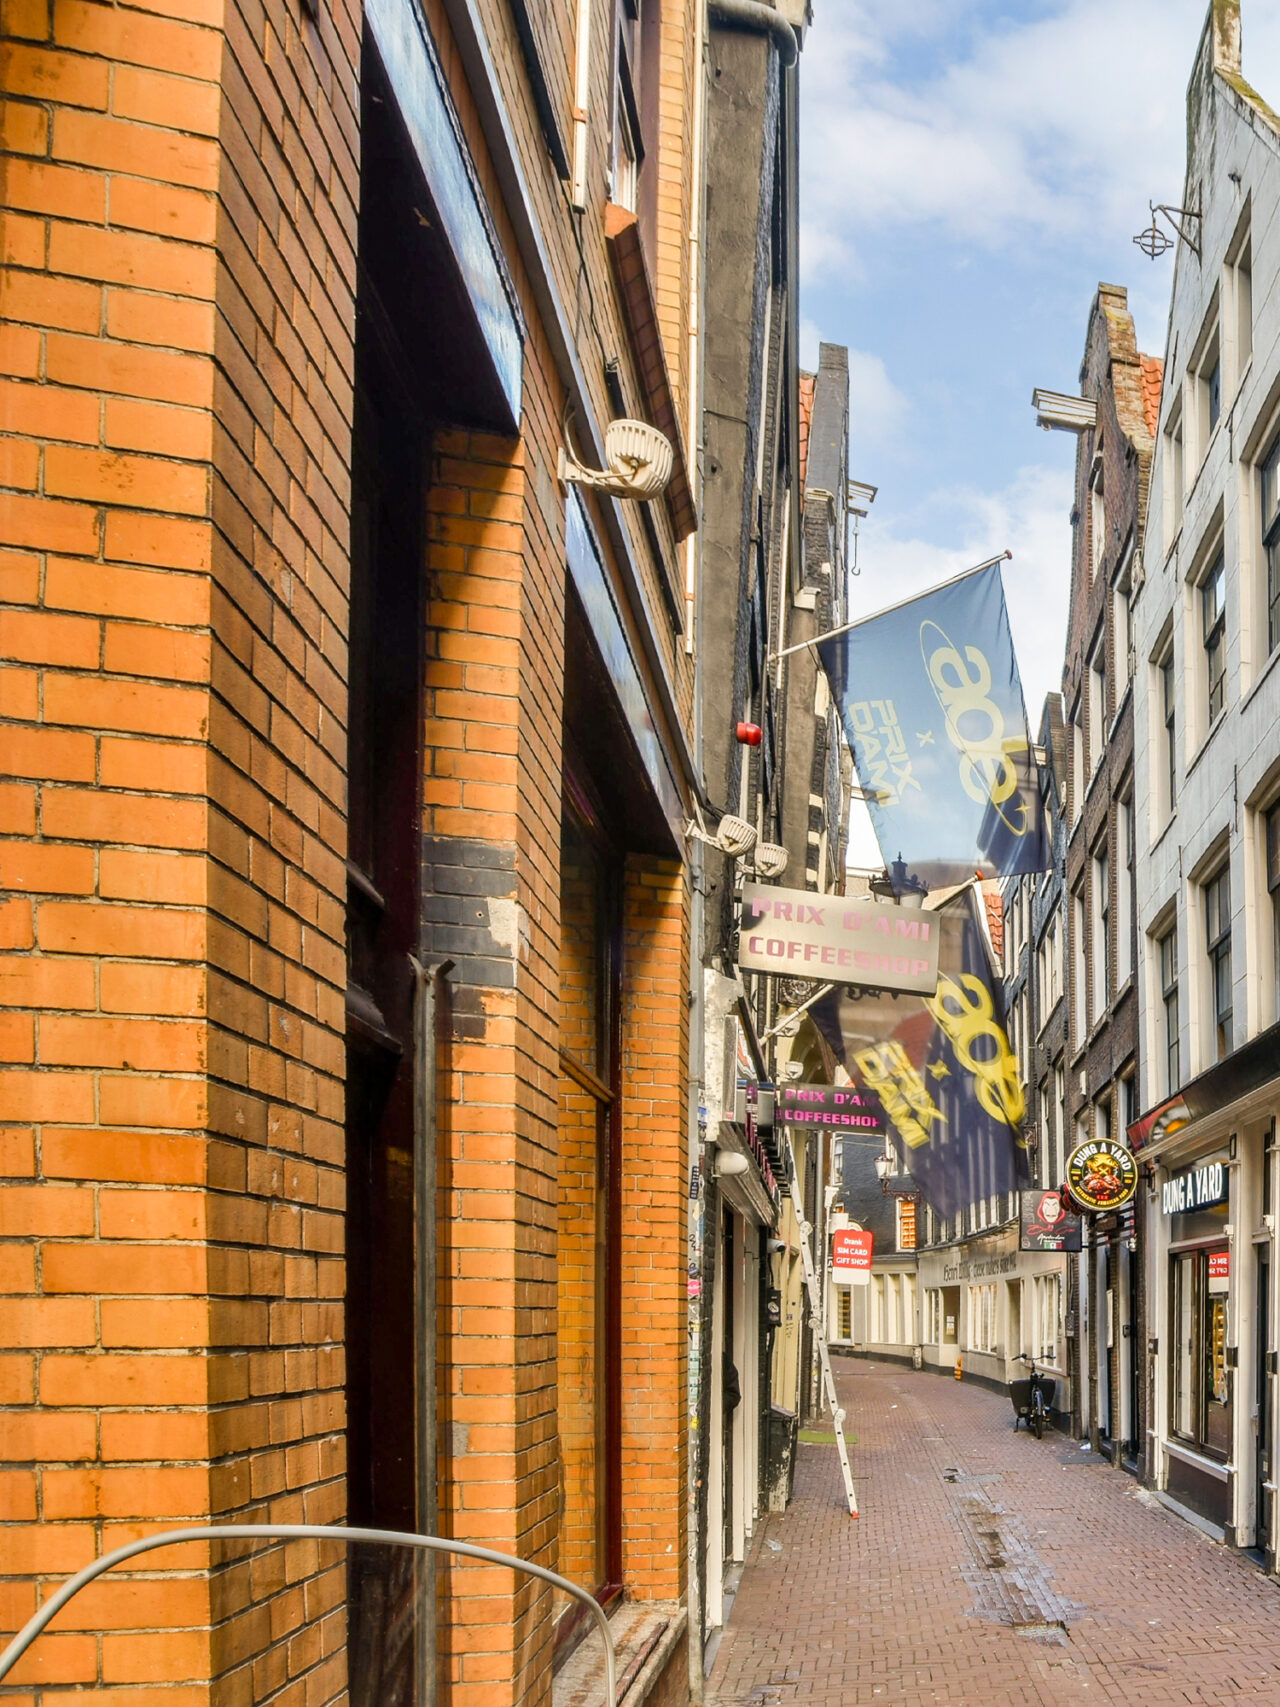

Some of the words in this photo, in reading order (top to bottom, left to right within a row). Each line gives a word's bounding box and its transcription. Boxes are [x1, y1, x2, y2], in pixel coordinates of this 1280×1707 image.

[870, 699, 922, 795] PRIX
[752, 896, 825, 927] PRIX
[843, 911, 930, 942] D'AMI
[749, 936, 930, 977] COFFEESHOP
[785, 1088, 826, 1103] PRIX
[1073, 1143, 1098, 1167] DUNG
[1100, 1142, 1107, 1153] A
[1110, 1145, 1132, 1170] YARD
[1163, 1176, 1185, 1214] DUNG
[1187, 1173, 1194, 1208] A
[1195, 1162, 1222, 1205] YARD
[850, 1248, 868, 1256] CARD
